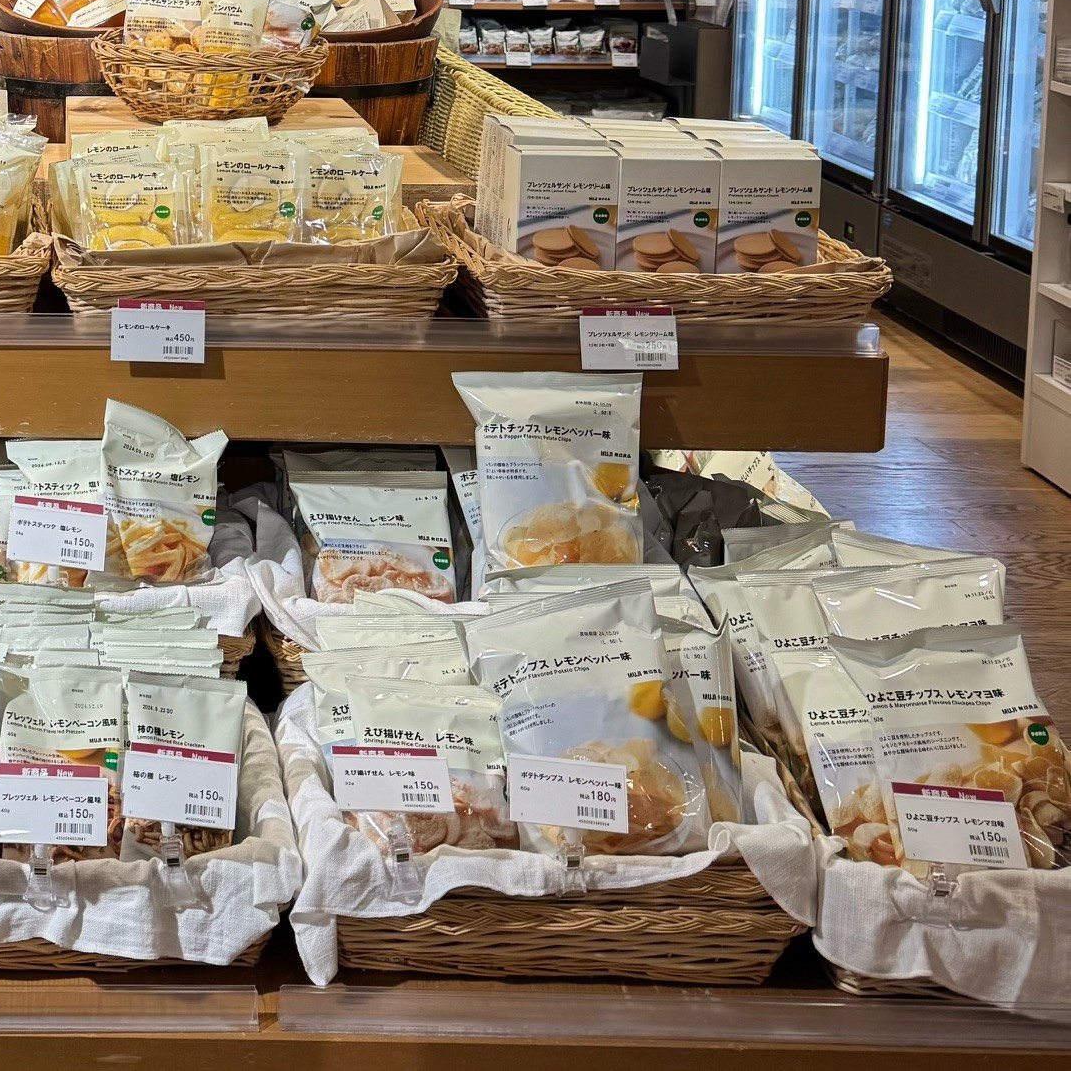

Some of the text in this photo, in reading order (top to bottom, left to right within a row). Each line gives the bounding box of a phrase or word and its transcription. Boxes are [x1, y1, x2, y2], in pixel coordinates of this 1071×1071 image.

[216, 161, 285, 171] レモンのロールケーキ
[309, 168, 379, 176] レモンのロールケーキ
[484, 424, 611, 440] ポテトチップス レモンペッパー味
[170, 474, 200, 483] 塩レモン
[309, 513, 404, 522] えび揚げせん レモン味
[17, 519, 82, 533] ポテトスティック 塩レモン
[729, 612, 754, 626] ひよこ
[554, 651, 632, 668] レモンペッパー味
[866, 688, 1005, 703] ひよこ豆チップス レモンマヨ味
[332, 704, 349, 716] えび
[6, 711, 45, 726] プレッツェル
[137, 725, 185, 739] 柿の種レモン
[364, 727, 475, 746] えび揚げせん レモン味
[57, 769, 74, 777] New
[133, 771, 177, 782] 柿の種 レモン
[403, 781, 439, 790] 税込150円
[521, 771, 622, 790] ポテトチップス レモンペッパー味
[2, 793, 101, 804] プレッツェル レモンベーコン風味
[189, 790, 223, 802] 税込150円
[580, 790, 616, 803] 税込180円
[59, 809, 93, 819] 税込150円
[906, 813, 1005, 828] ひよこ豆チップス レモンマヨ味
[970, 831, 1007, 843] 税込150円
